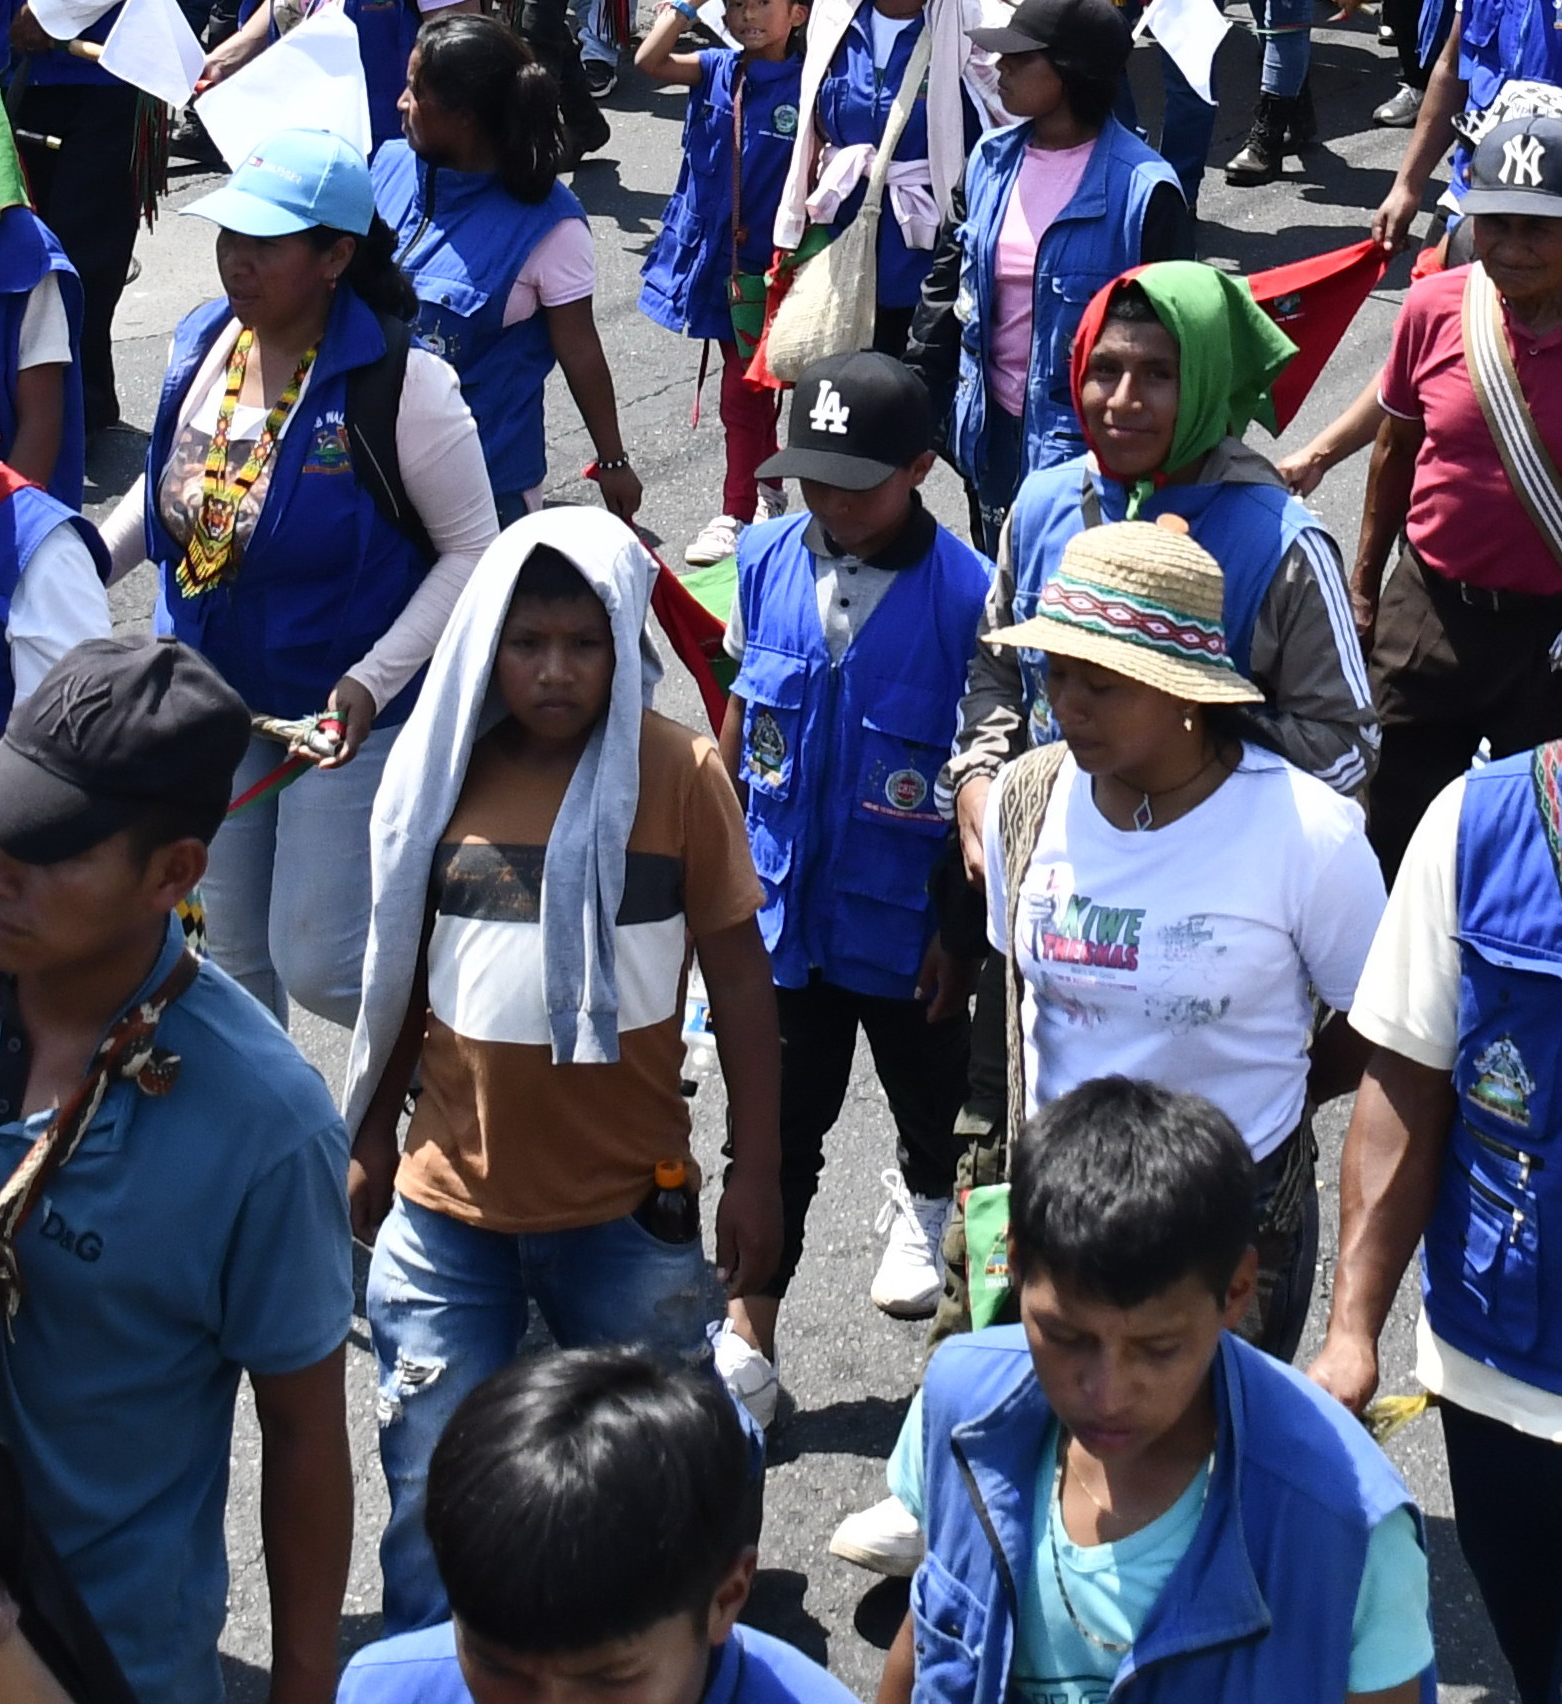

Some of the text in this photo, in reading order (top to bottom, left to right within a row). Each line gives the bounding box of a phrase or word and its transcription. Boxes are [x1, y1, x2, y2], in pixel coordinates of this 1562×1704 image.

[1498, 134, 1545, 186] NY
[810, 379, 850, 434] LA
[1056, 894, 1146, 946] KIWE
[39, 1210, 104, 1263] D&G
